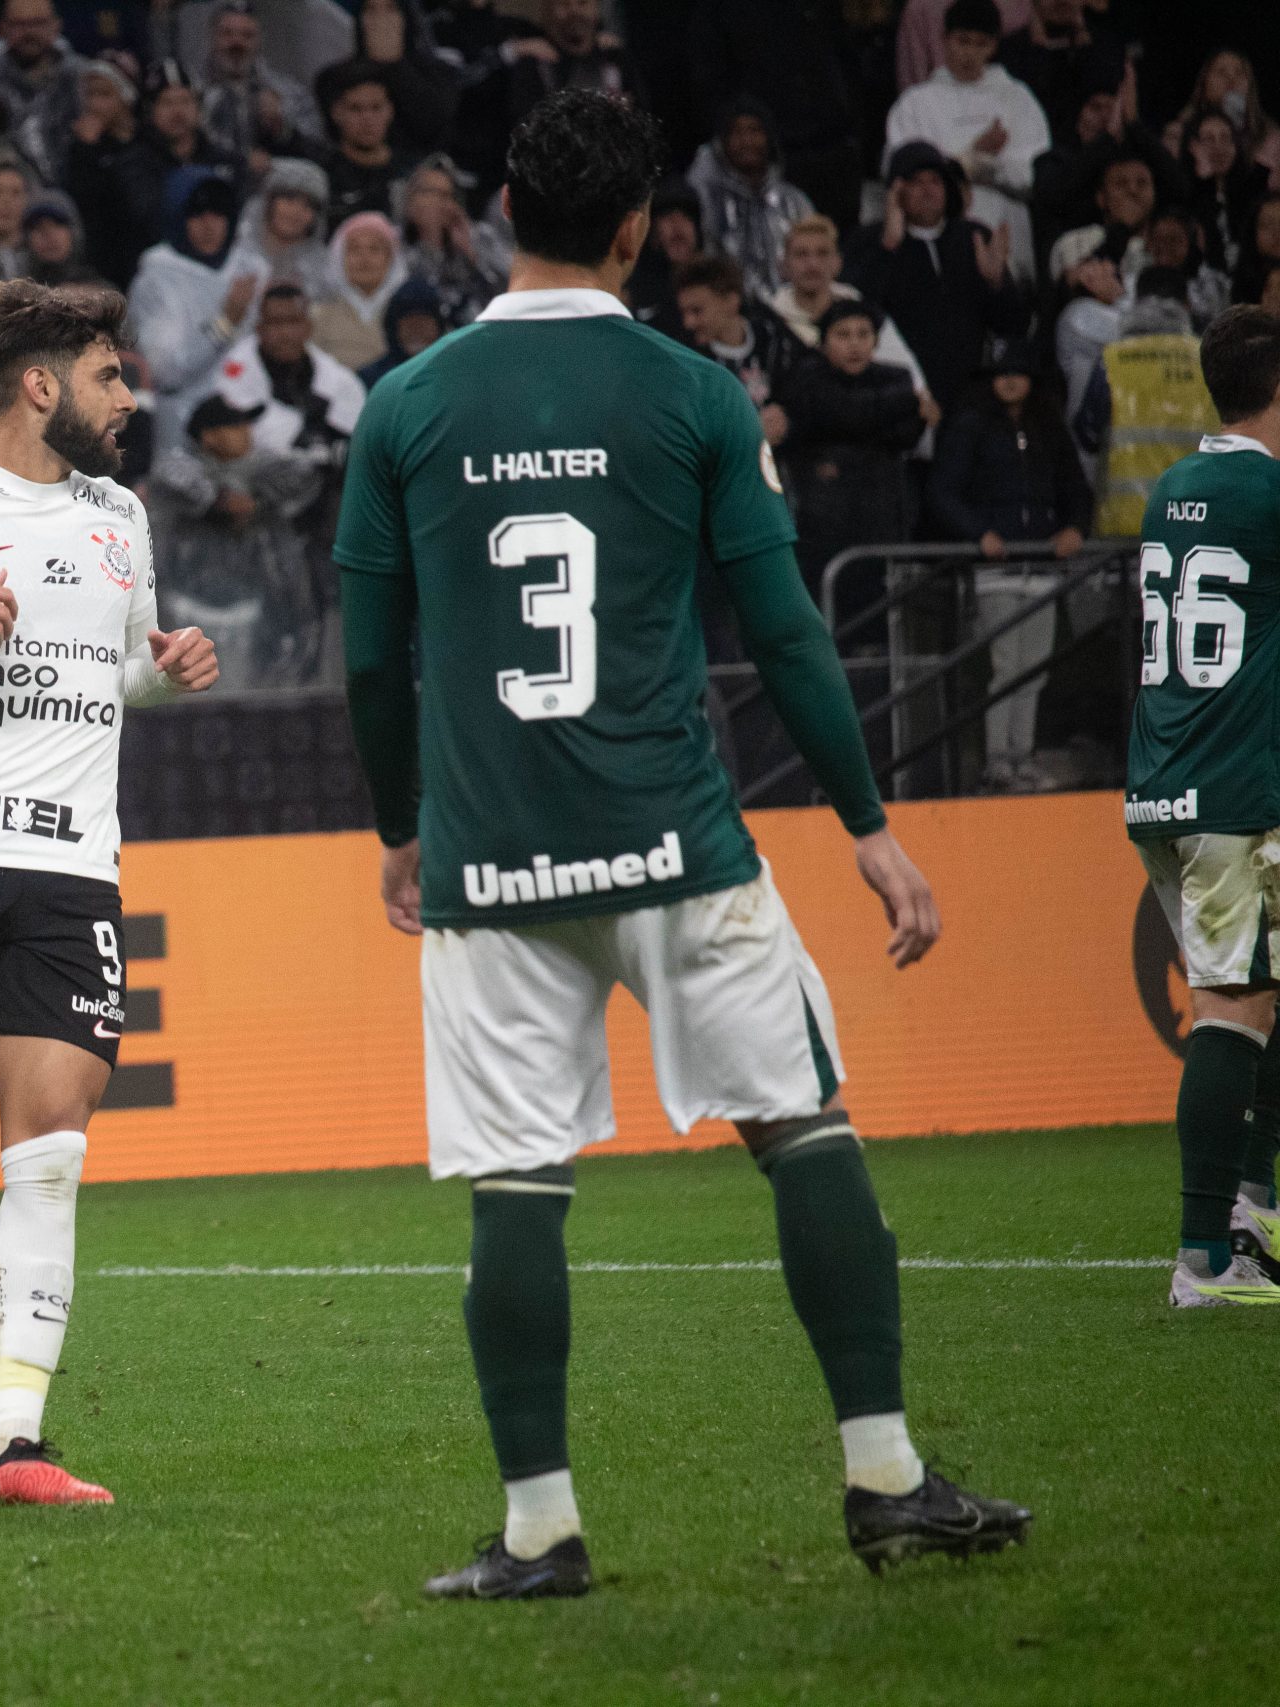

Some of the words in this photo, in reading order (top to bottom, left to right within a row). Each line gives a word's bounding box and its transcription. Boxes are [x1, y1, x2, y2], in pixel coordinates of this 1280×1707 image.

[464, 455, 488, 483] L.
[493, 448, 607, 481] HALTER
[1166, 500, 1207, 522] HUGO
[42, 575, 82, 585] ALE
[488, 512, 596, 721] 3
[1140, 542, 1250, 688] 66
[1124, 788, 1198, 824] nimed
[463, 830, 685, 907] Unimed
[92, 920, 122, 986] 9
